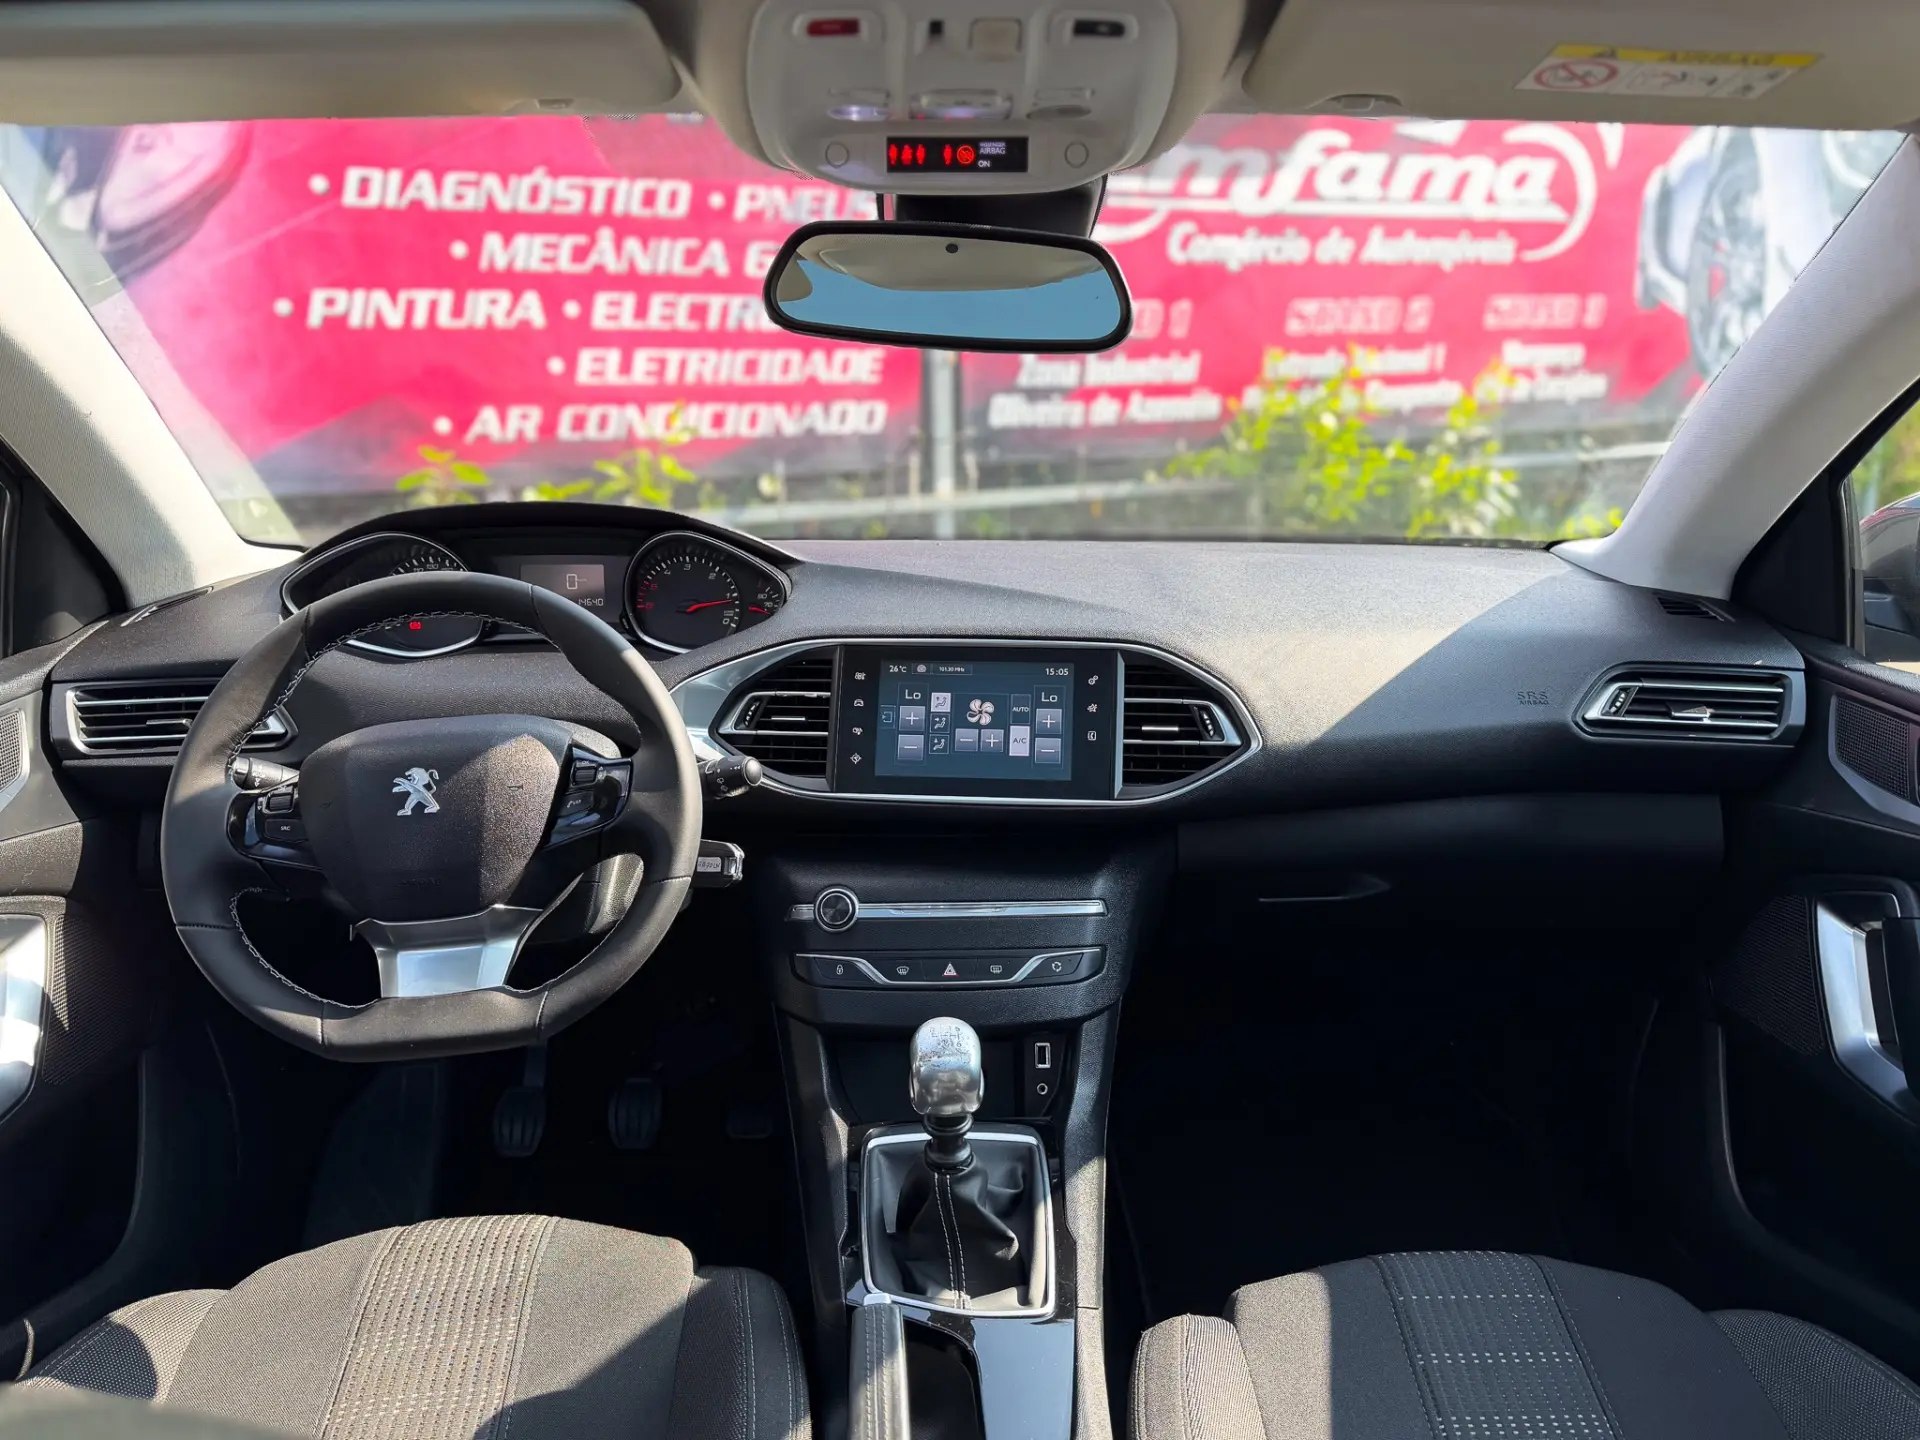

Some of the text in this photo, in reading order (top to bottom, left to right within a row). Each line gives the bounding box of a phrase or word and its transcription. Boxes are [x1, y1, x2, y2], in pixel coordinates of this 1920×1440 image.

[979, 147, 1006, 155] AIRBAG
[977, 160, 991, 168] ON
[342, 166, 692, 218] DIAGNÓSTICO
[734, 184, 878, 222] PNEUS
[478, 226, 730, 276] MECÂNICA
[306, 288, 547, 330] PINTURA
[575, 347, 887, 386] ELETRICIDADE
[464, 400, 888, 445] AR CONDICIONADO
[1045, 668, 1069, 676] 15:05
[905, 689, 922, 700] Lo
[1041, 691, 1058, 703] Lo
[1517, 691, 1548, 700] SRS
[1012, 736, 1027, 745] A/C
